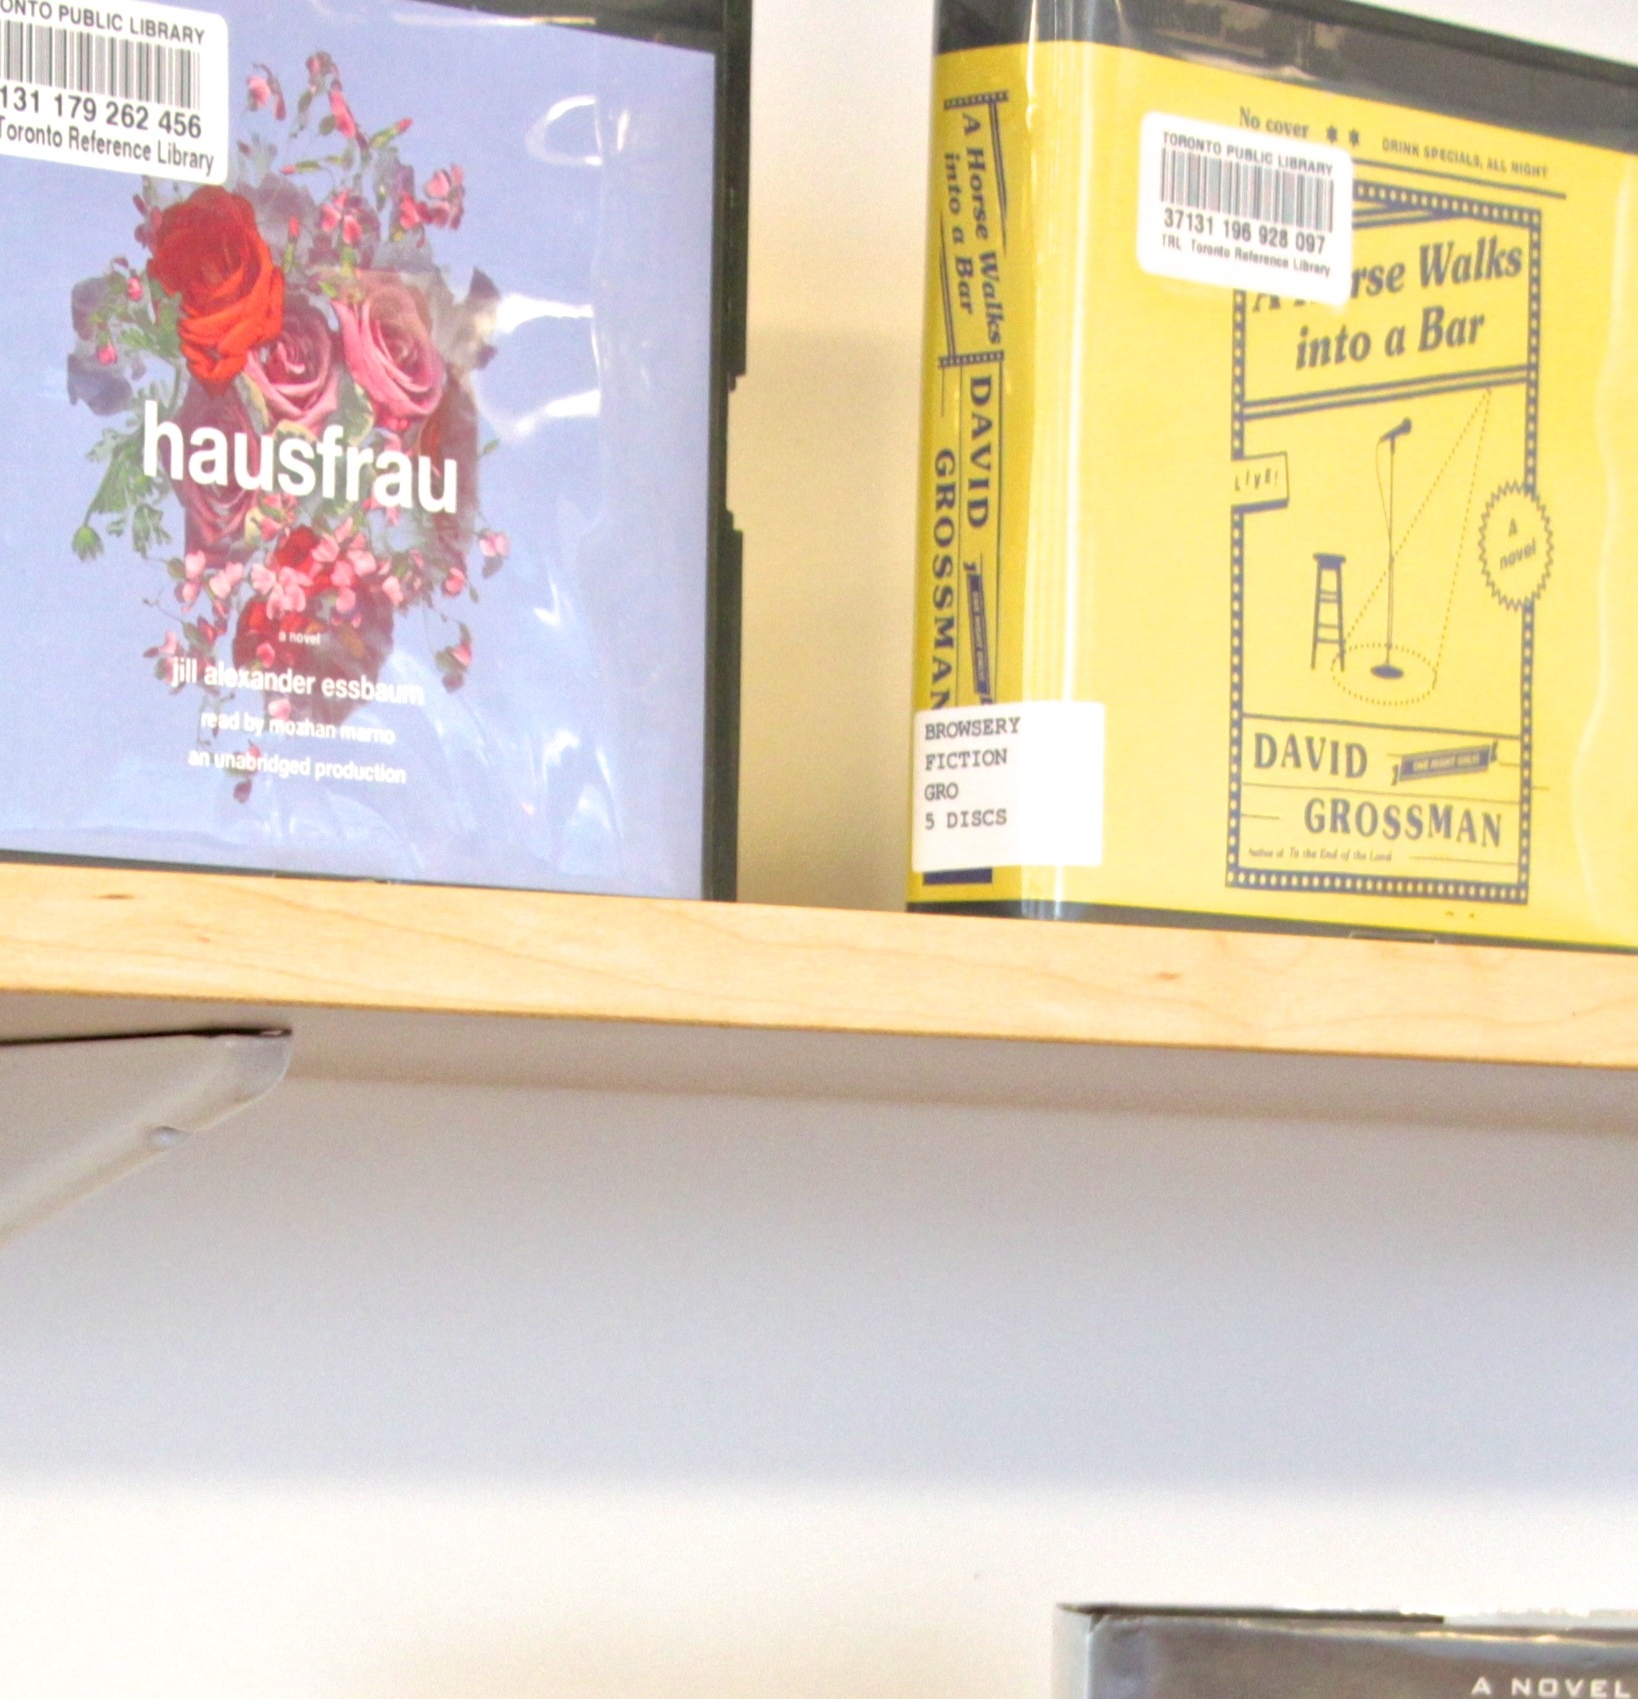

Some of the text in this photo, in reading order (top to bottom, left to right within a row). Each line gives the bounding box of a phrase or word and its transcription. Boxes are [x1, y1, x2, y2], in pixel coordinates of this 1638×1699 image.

[59, 5, 205, 45] PUBLIC LIBRARY
[54, 93, 97, 122] 179
[105, 101, 149, 130] 262
[158, 110, 202, 139] 456
[1266, 118, 1310, 138] cover
[68, 126, 151, 162] Reference
[158, 140, 214, 177] Library
[1163, 131, 1334, 176] TORONTO PUBLIC LIBRARY
[944, 151, 975, 315] into Bar
[961, 112, 1003, 346] A Horse Walks
[1164, 207, 1326, 256] 37131 196 928 097
[1419, 234, 1523, 289] Walks
[1295, 305, 1486, 371] into a Bar
[143, 399, 458, 514] hausfrau
[966, 375, 993, 529] DAVID
[1499, 537, 1537, 571] novel
[930, 448, 958, 711] GROSSMAN
[170, 657, 425, 706] jill alexander essbaum
[200, 709, 266, 735] read by
[924, 716, 1021, 741] BROWSERY
[213, 750, 407, 785] unabridged production
[924, 748, 1008, 772] FICTION
[1253, 732, 1369, 780] DAVID
[924, 782, 959, 801] GRO
[924, 808, 1008, 830] 5 DISCS
[1304, 797, 1502, 849] GROSSMAN
[1470, 1676, 1493, 1698] A
